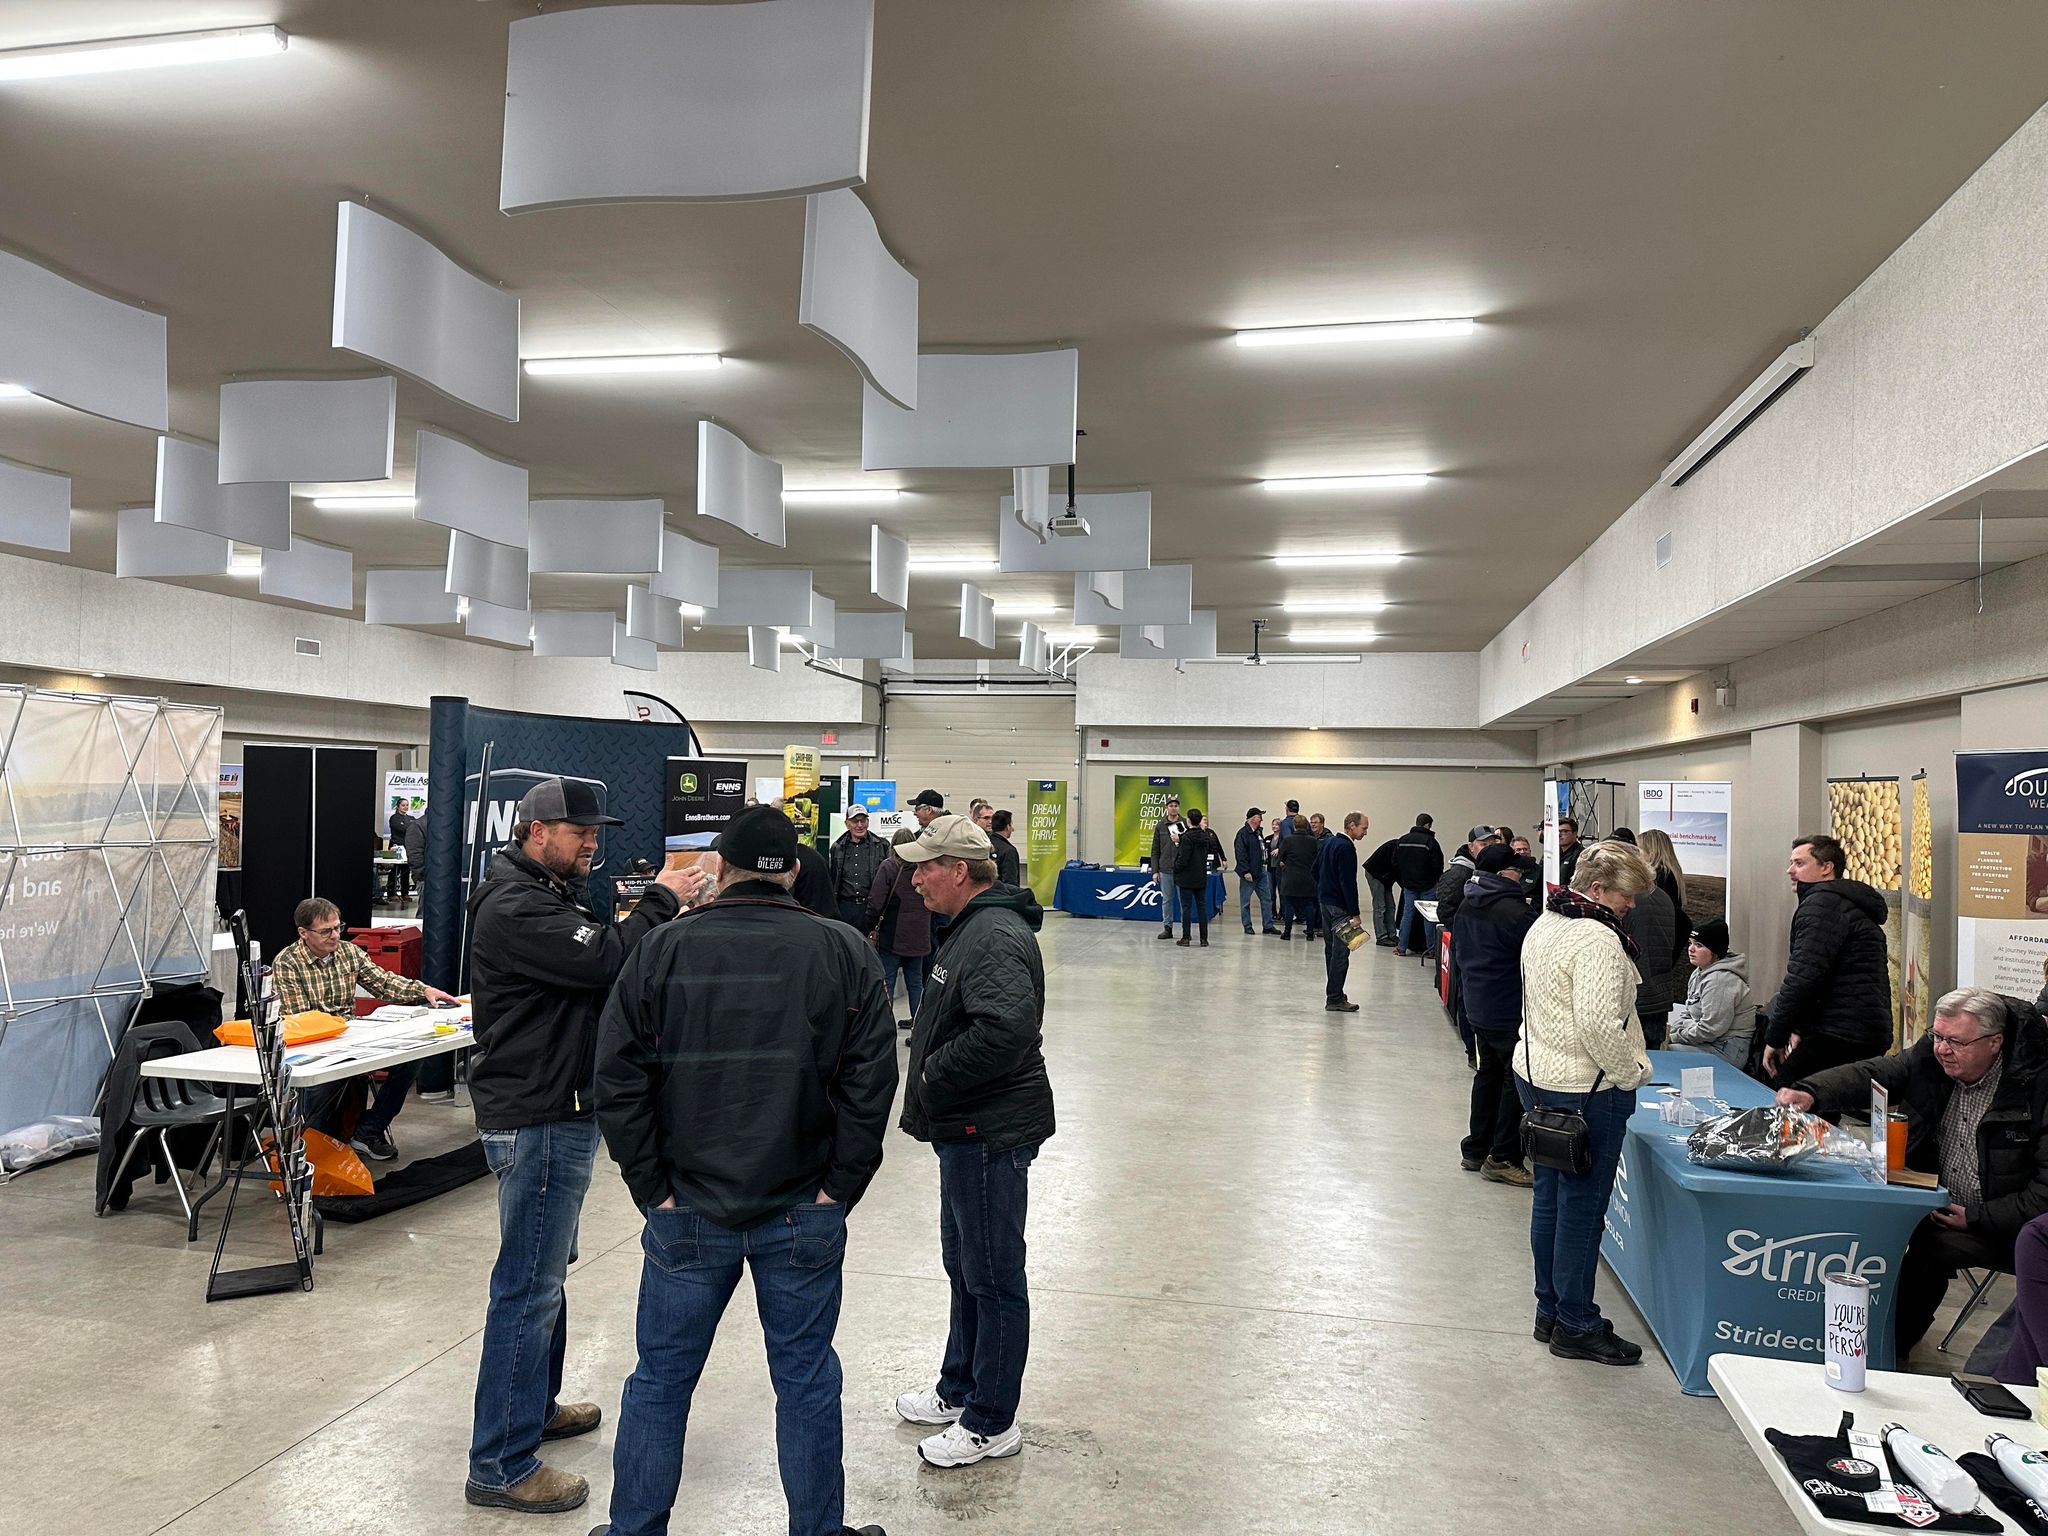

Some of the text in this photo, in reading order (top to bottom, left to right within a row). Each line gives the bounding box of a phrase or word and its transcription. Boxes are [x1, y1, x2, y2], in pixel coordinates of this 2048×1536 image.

[394, 776, 416, 785] Delta
[716, 783, 741, 791] ENNS
[1645, 789, 1663, 798] BDO
[1032, 804, 1061, 815] DREAM
[880, 814, 902, 825] MASC
[1032, 816, 1058, 828] GROW
[1032, 829, 1058, 841] THRIVE
[1680, 833, 1717, 842] benchmarking
[757, 860, 784, 870] OILERS
[1124, 881, 1164, 909] fcc
[2005, 947, 2027, 956] Journey
[2005, 957, 2035, 965] institutions
[1995, 974, 2019, 983] planning
[1721, 1229, 1887, 1290] Stride
[1834, 1303, 1866, 1327] YOU'RE
[1828, 1321, 1867, 1348] my
